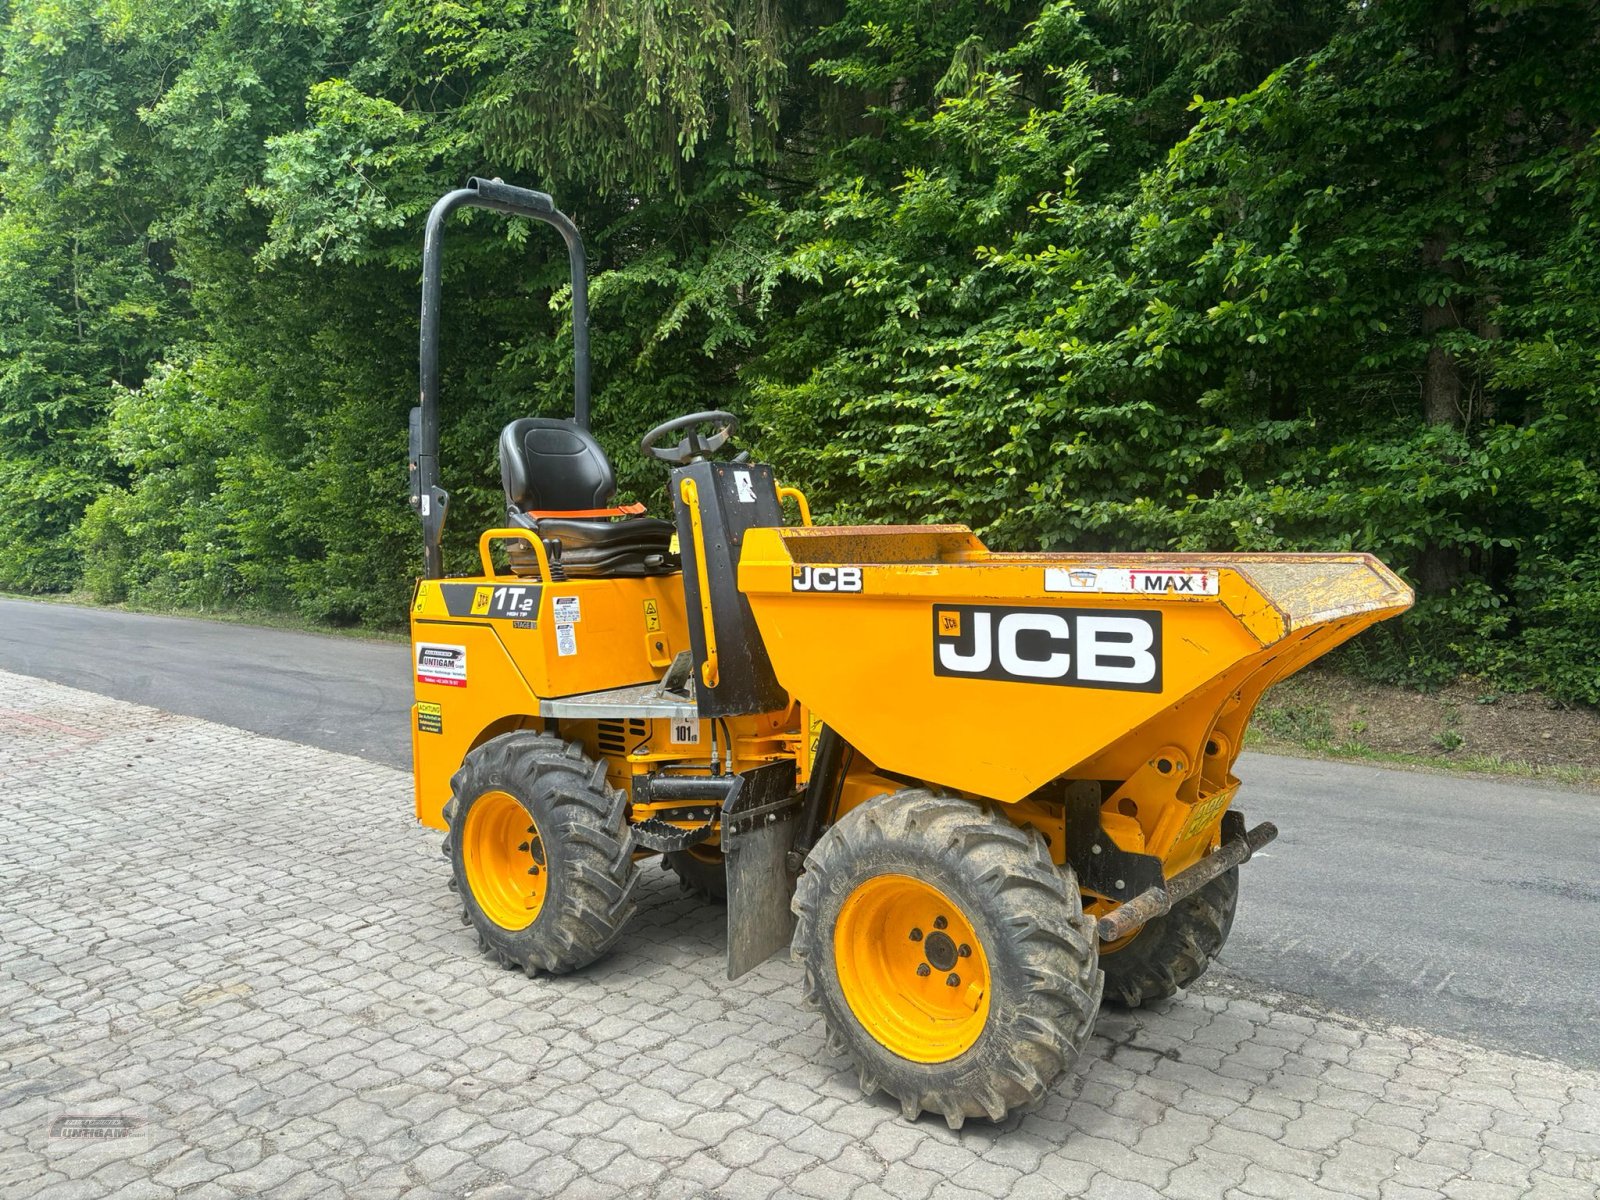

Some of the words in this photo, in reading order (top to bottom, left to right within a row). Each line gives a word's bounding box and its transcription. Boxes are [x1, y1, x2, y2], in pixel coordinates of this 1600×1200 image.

[793, 567, 862, 591] JCB
[1144, 575, 1194, 592] MAX
[513, 621, 530, 629] STAGE
[943, 617, 958, 630] JCB
[939, 612, 1156, 684] JCB
[419, 703, 440, 714] ACHTUNG
[676, 726, 691, 741] 101
